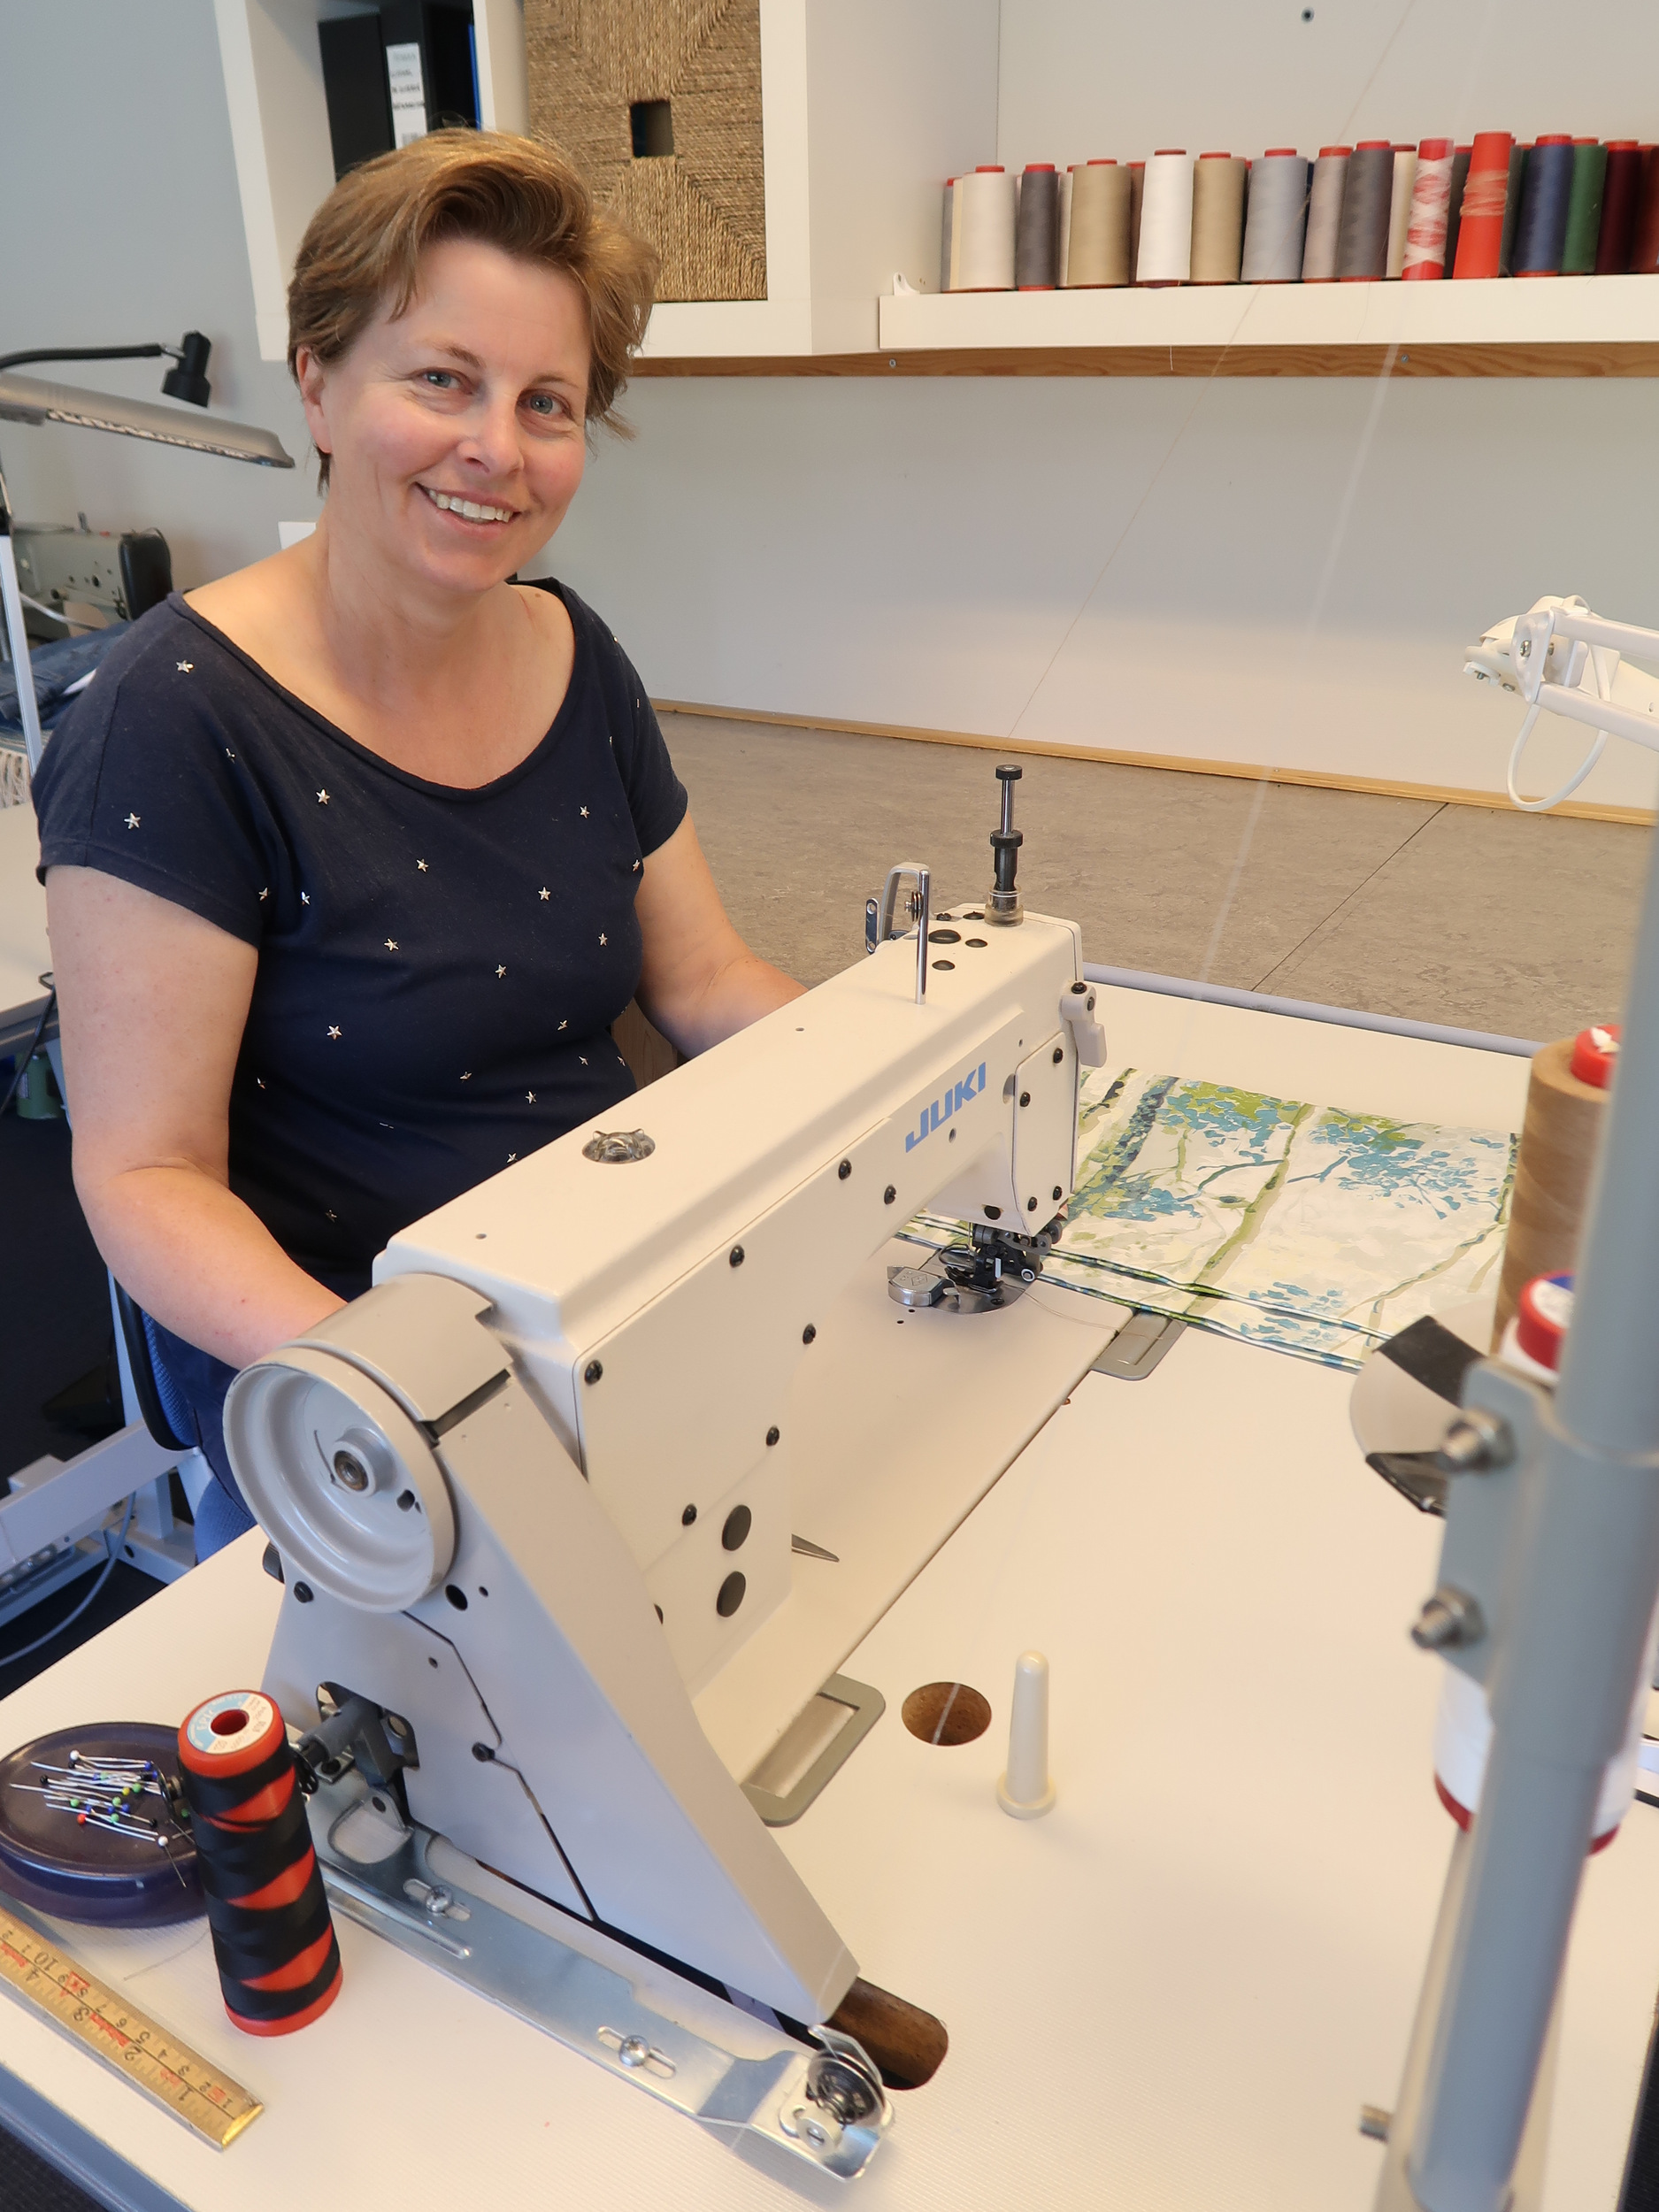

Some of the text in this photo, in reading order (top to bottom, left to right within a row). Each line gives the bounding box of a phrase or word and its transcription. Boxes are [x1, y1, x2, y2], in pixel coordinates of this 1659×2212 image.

[905, 1061, 987, 1153] JUKI
[35, 1951, 58, 1971] 10
[26, 1967, 40, 1982] 4
[58, 1974, 69, 1984] 9
[73, 2006, 89, 2022] 3
[96, 2003, 107, 2013] 7
[116, 2017, 127, 2028] 6
[135, 2031, 150, 2044] 5
[125, 2045, 142, 2062] 2
[157, 2048, 167, 2059] 4
[178, 2065, 189, 2076] 3
[179, 2084, 194, 2101] 1
[199, 2081, 211, 2093] 2
[222, 2098, 233, 2108] 1
